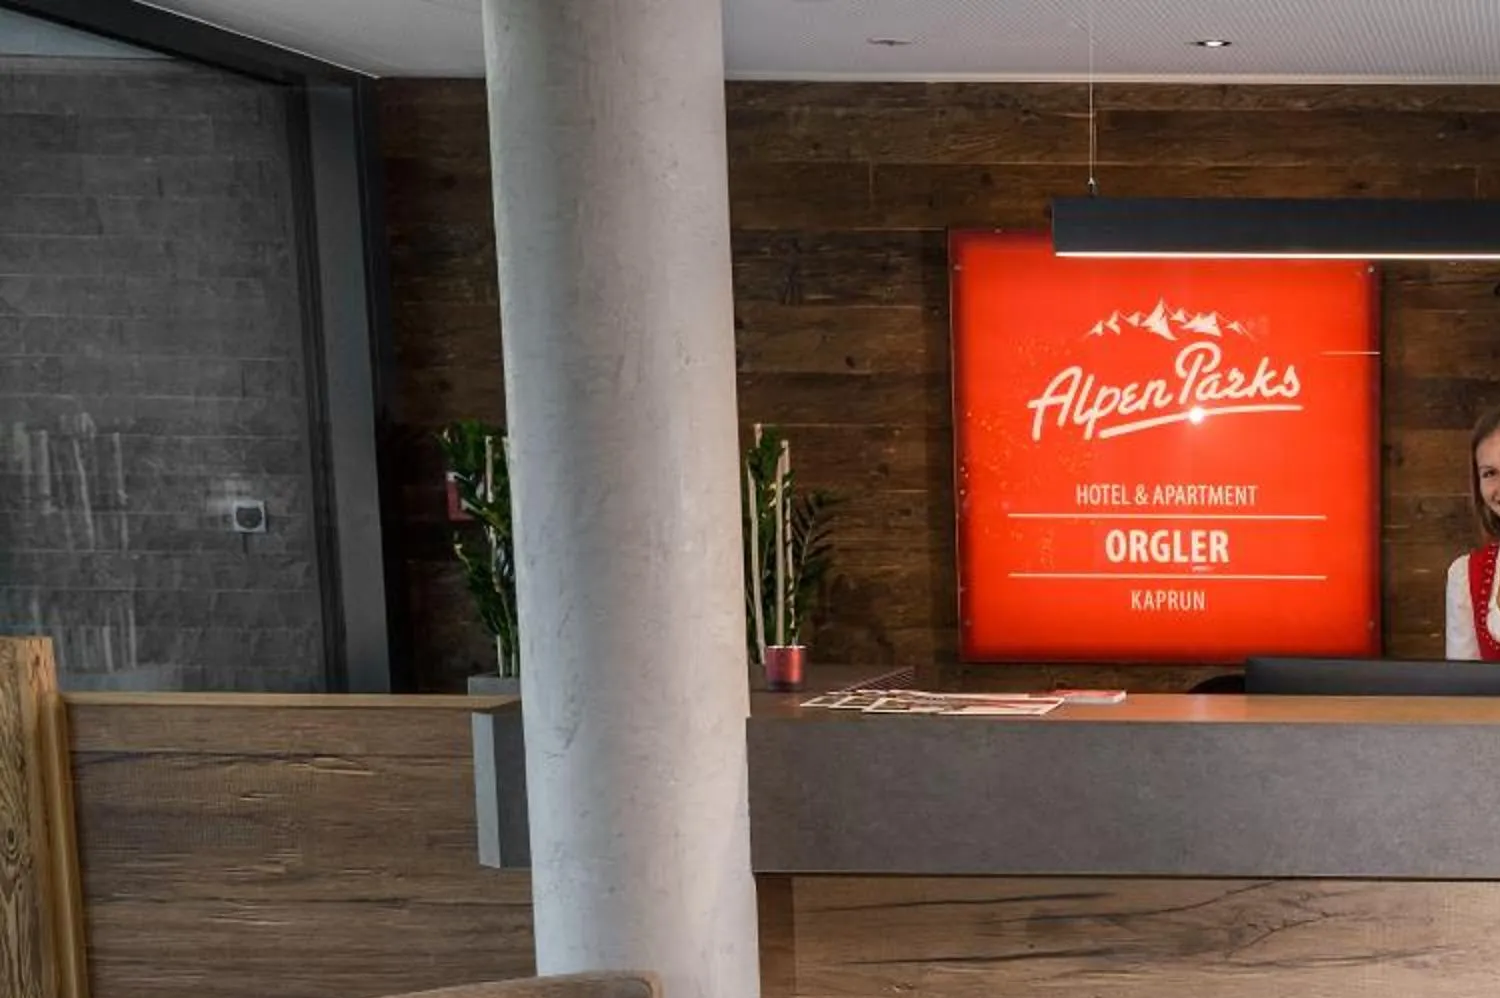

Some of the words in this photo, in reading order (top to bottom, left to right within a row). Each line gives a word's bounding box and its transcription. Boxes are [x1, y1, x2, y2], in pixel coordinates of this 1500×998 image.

[1076, 484, 1131, 506] HOTEL
[1134, 484, 1149, 506] &
[1152, 484, 1258, 506] APARTMENT
[1104, 528, 1230, 563] ORGLER
[1131, 590, 1206, 611] KAPRUN
